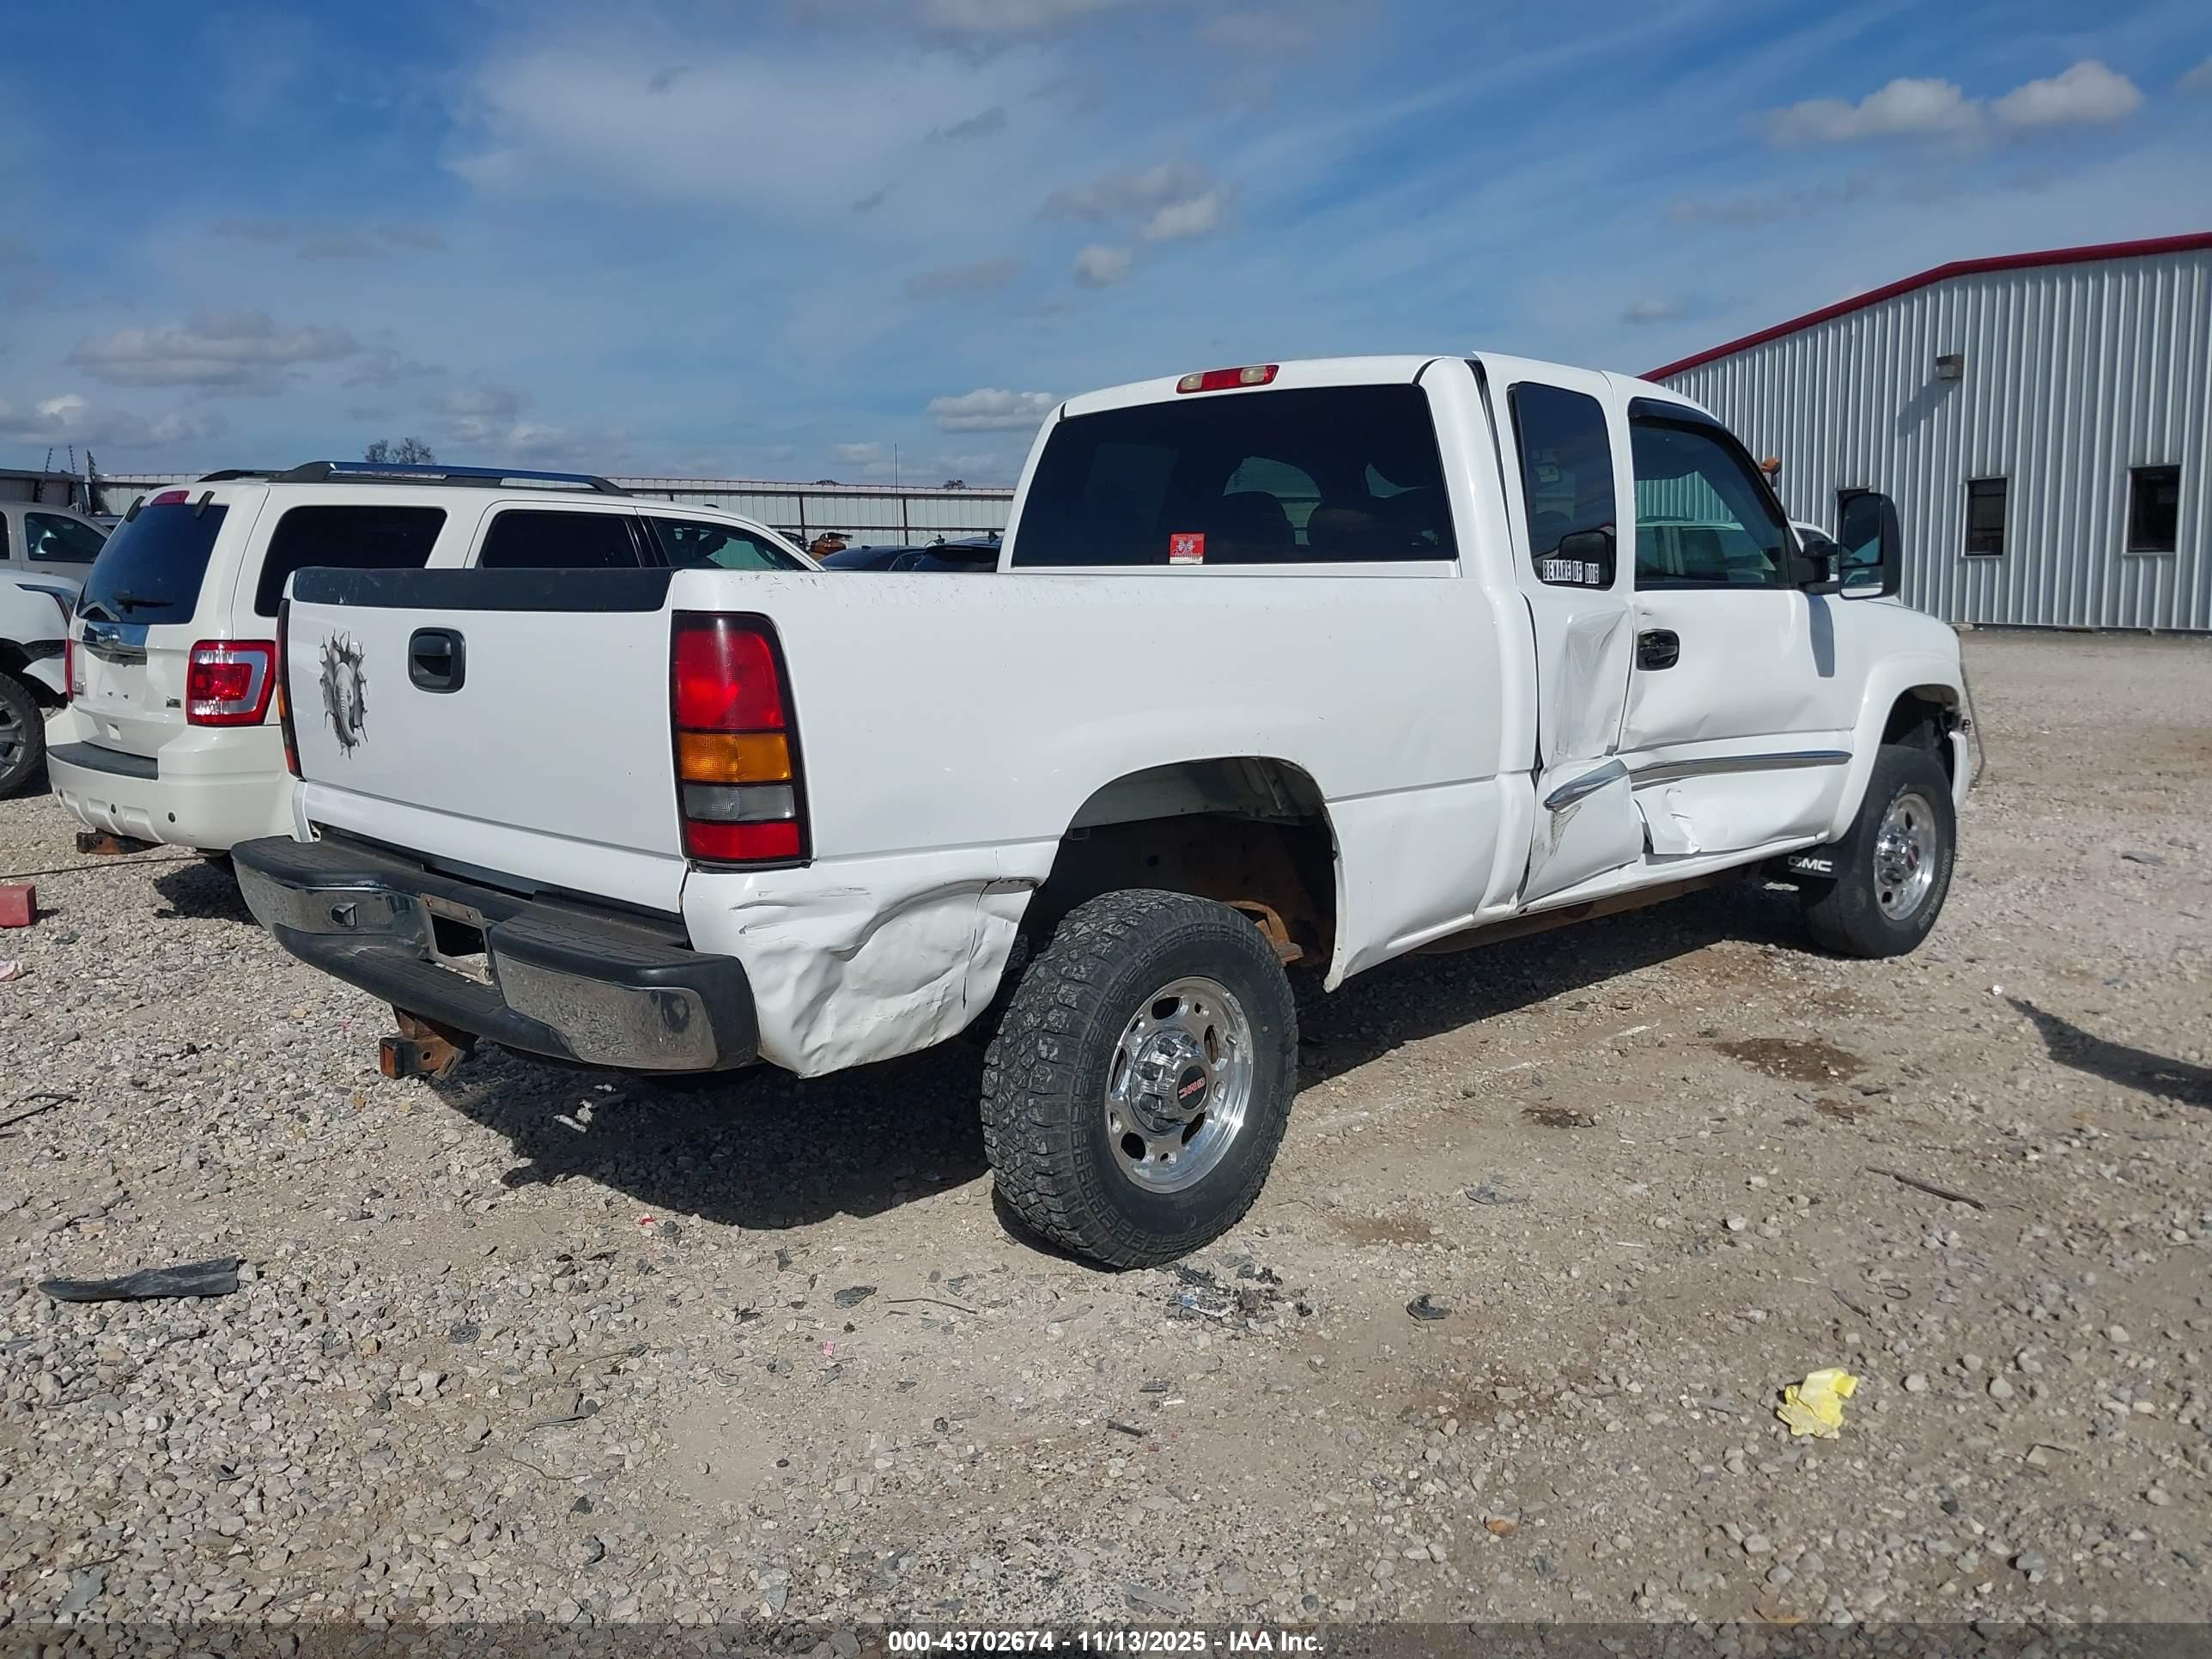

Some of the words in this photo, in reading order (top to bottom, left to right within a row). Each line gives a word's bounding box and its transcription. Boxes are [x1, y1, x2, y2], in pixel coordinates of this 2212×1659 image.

[1544, 561, 1571, 580] BEWARE
[1573, 562, 1582, 581] OF
[1585, 564, 1599, 583] DOG
[1787, 855, 1832, 872] GMC
